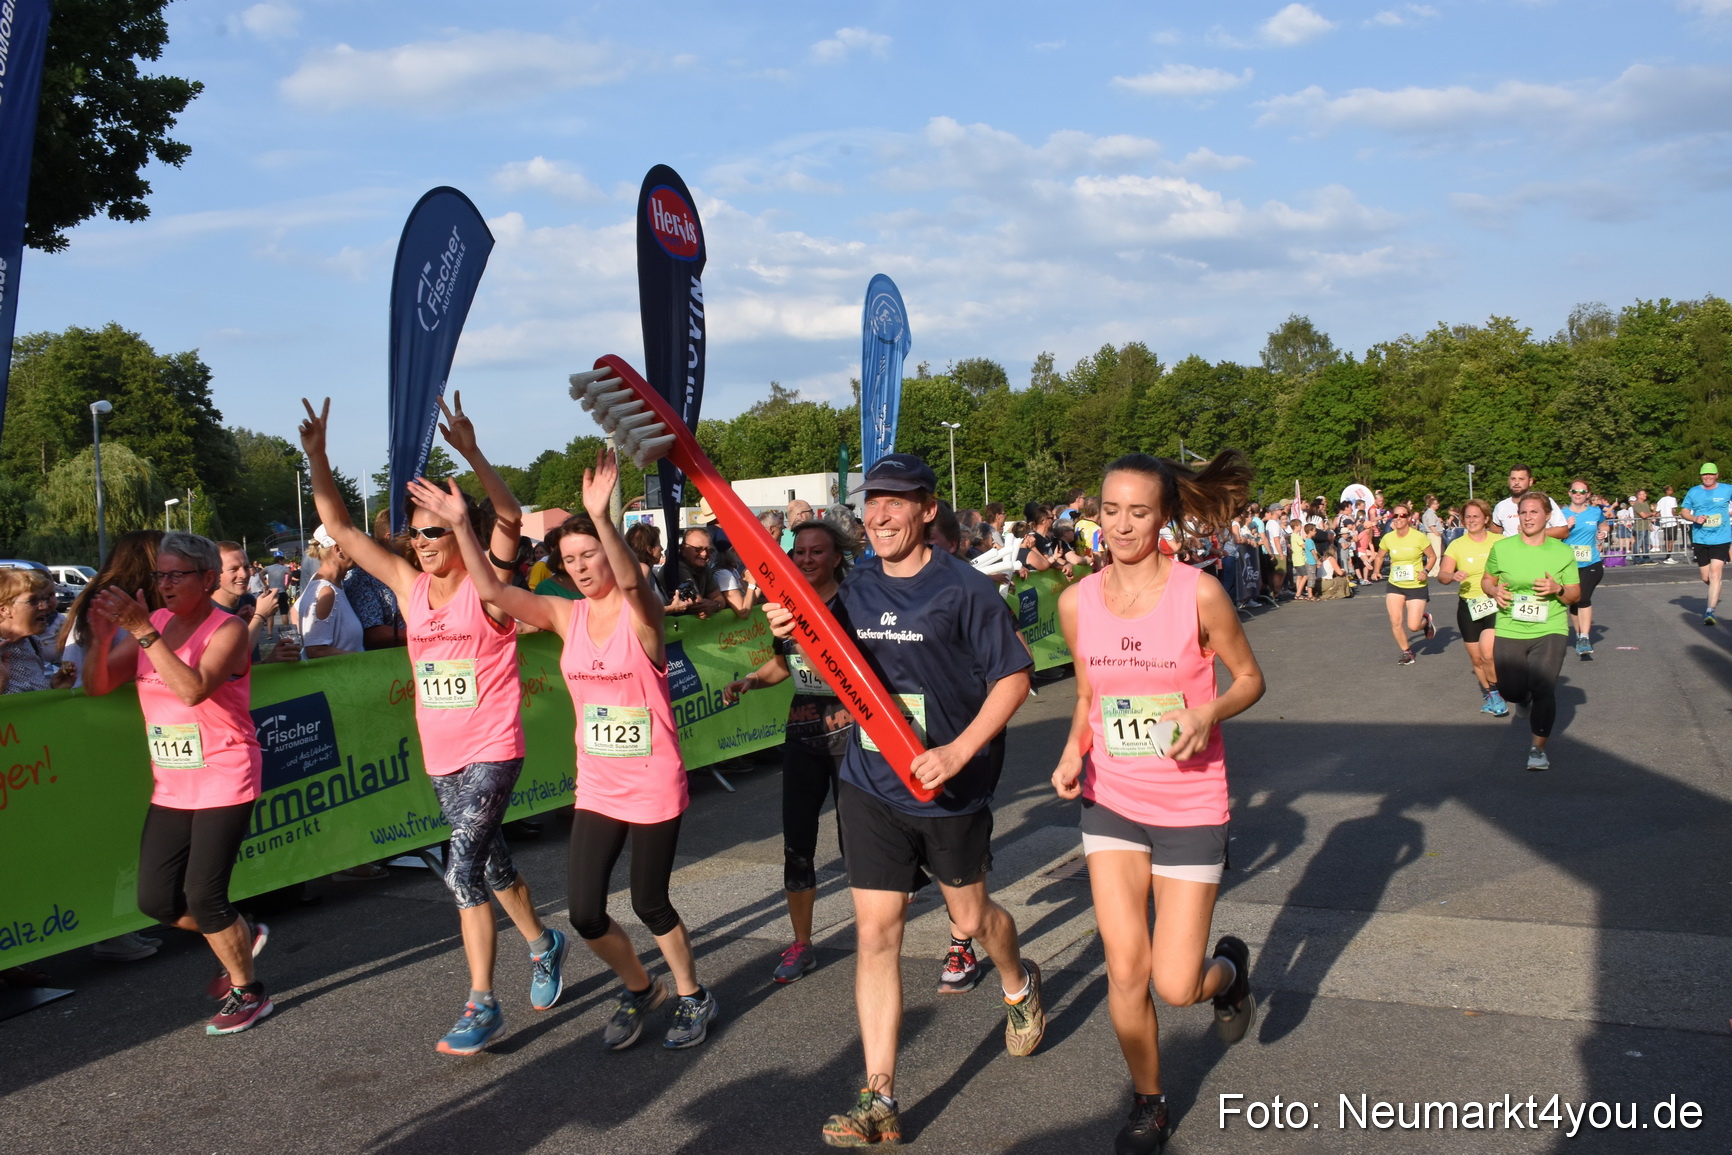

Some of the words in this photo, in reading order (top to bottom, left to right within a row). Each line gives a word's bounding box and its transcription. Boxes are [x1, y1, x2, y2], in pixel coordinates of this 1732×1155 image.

[651, 197, 697, 245] Hervis
[427, 225, 461, 316] Fischer
[442, 242, 467, 315] AUTOMOBILE
[1472, 600, 1494, 614] 1233
[1519, 604, 1540, 616] 451
[430, 620, 446, 632] Die
[881, 611, 898, 626] Die
[718, 617, 768, 651] Gesunde
[758, 562, 776, 588] DR.
[779, 590, 820, 645] HELMUT
[820, 649, 874, 721] HOFMANN
[856, 628, 924, 644] Kieferorthopäden
[1121, 636, 1142, 652] Die
[747, 642, 775, 667] laufe
[1089, 656, 1178, 672] Kieferorthopäden
[592, 659, 606, 671] Die
[667, 660, 685, 672] cher
[423, 677, 467, 696] 1119
[567, 671, 634, 683] Kieferorthopäden
[266, 720, 321, 747] Fischer
[591, 723, 641, 744] 1123
[1113, 718, 1158, 740] 112
[153, 740, 193, 758] 1114
[274, 734, 319, 754] AUTOMOBILE
[244, 736, 411, 842] rmenlauf
[0, 903, 80, 951] alz.de
